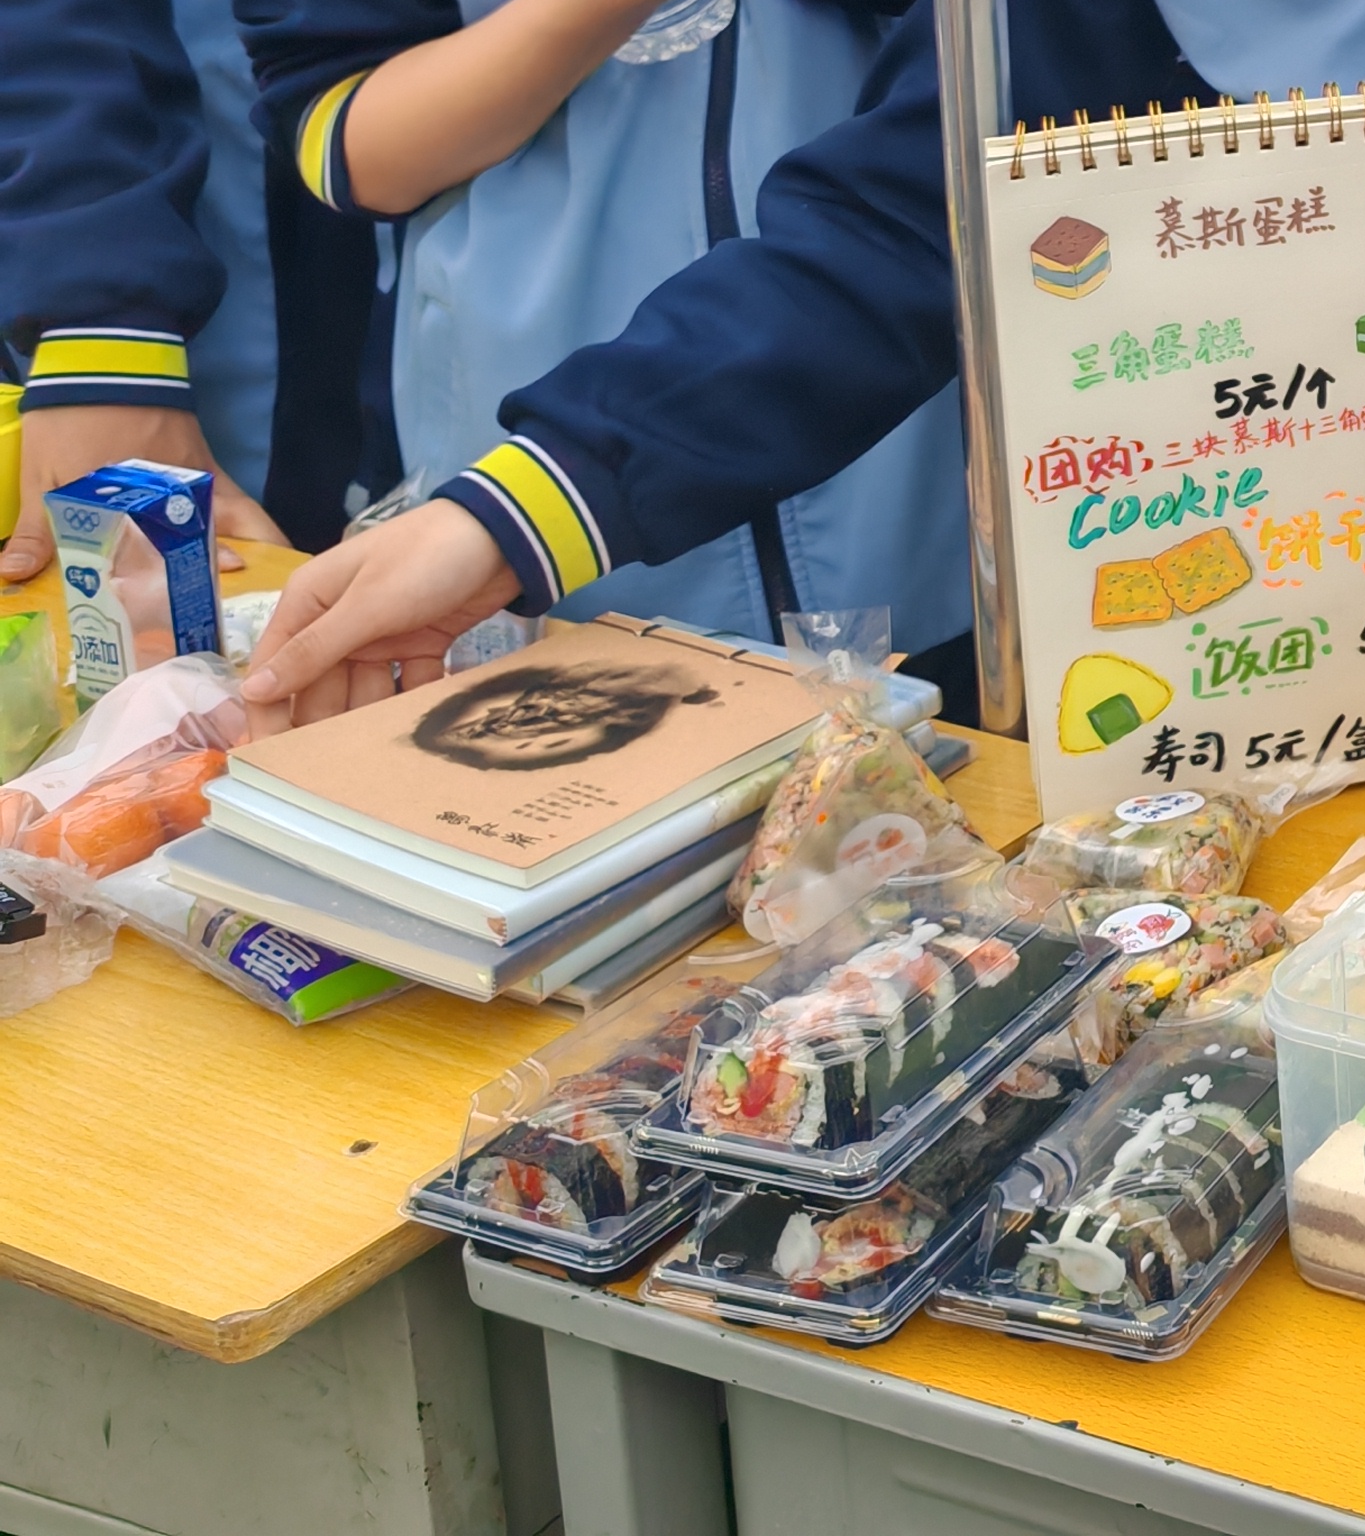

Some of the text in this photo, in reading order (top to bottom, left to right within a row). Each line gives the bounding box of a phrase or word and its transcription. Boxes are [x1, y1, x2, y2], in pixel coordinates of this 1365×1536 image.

[1071, 317, 1254, 392] 三角蛋糕
[1214, 363, 1336, 419] 5元/个
[1068, 467, 1268, 550] Cookie
[1204, 627, 1313, 688] 饭团
[1142, 725, 1225, 783] 寿司
